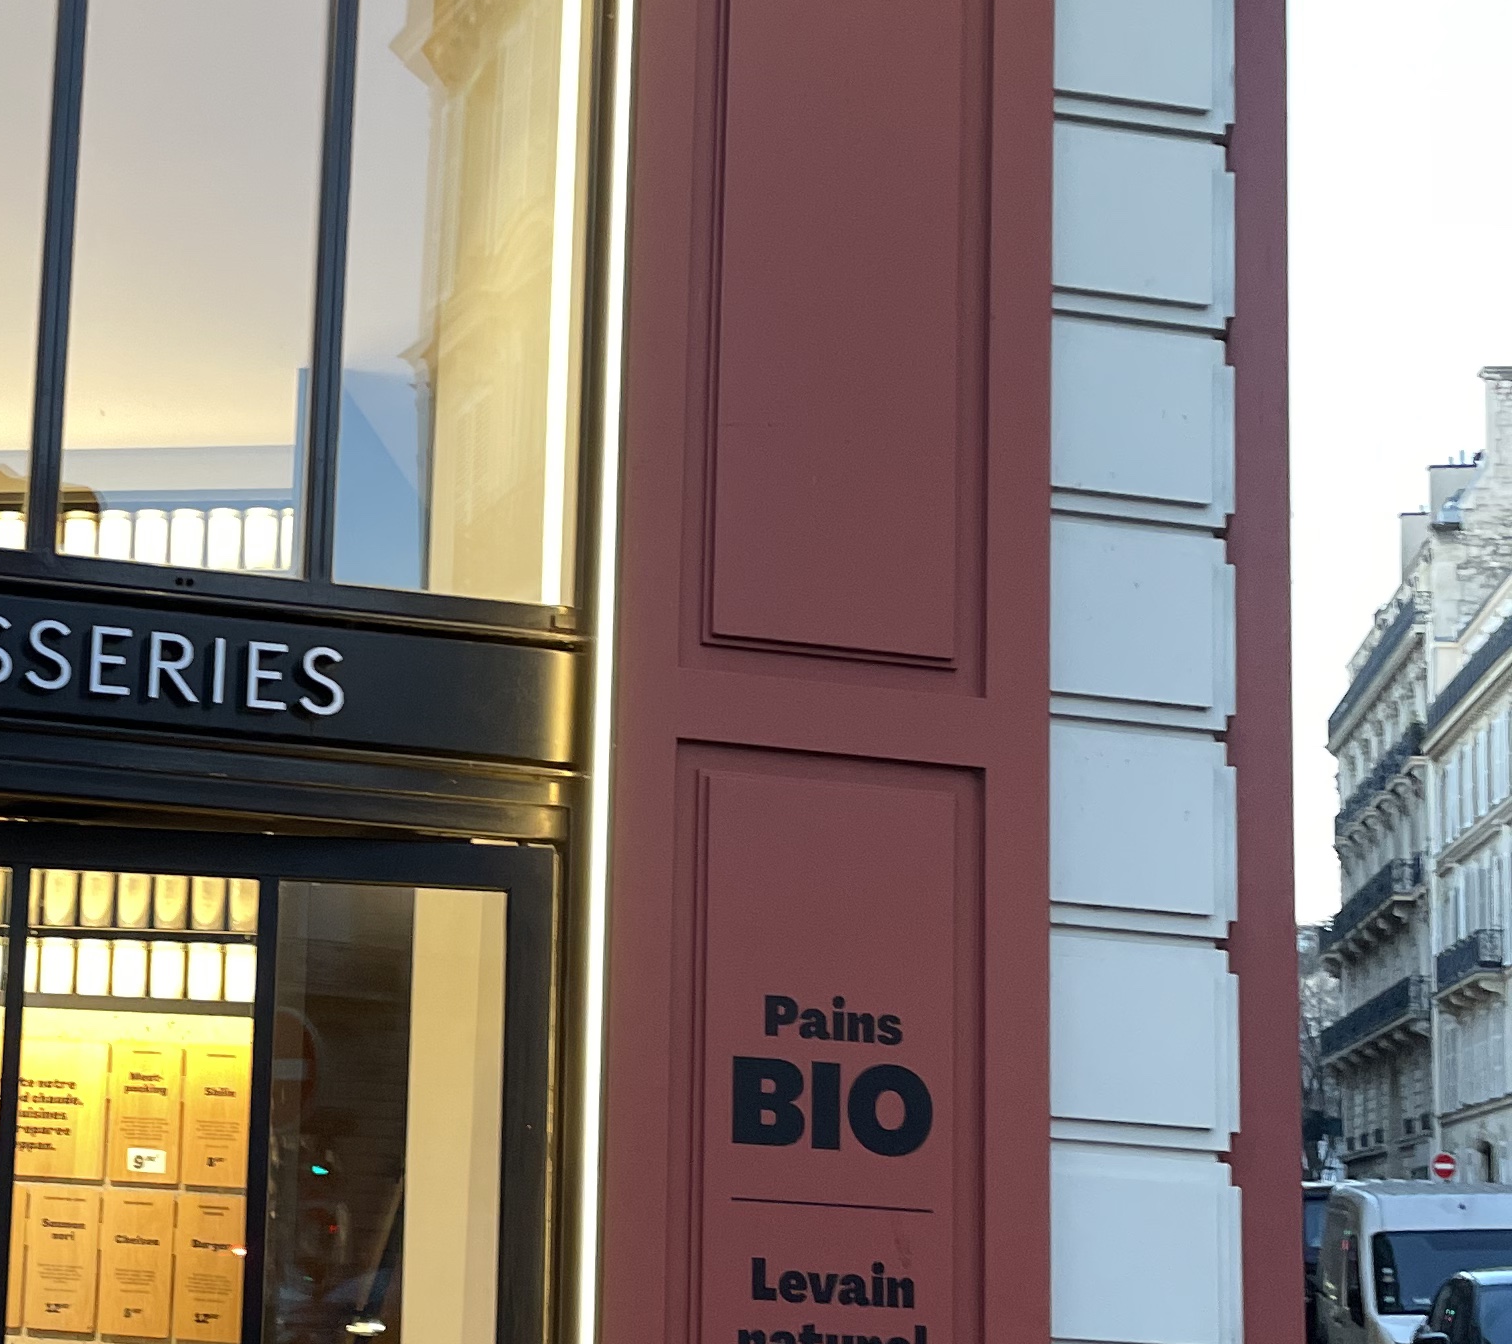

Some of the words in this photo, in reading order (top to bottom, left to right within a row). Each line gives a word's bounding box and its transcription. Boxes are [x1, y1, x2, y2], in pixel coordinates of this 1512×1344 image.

[763, 994, 904, 1046] Pains
[731, 1055, 934, 1158] BIO
[751, 1257, 915, 1310] Levain
